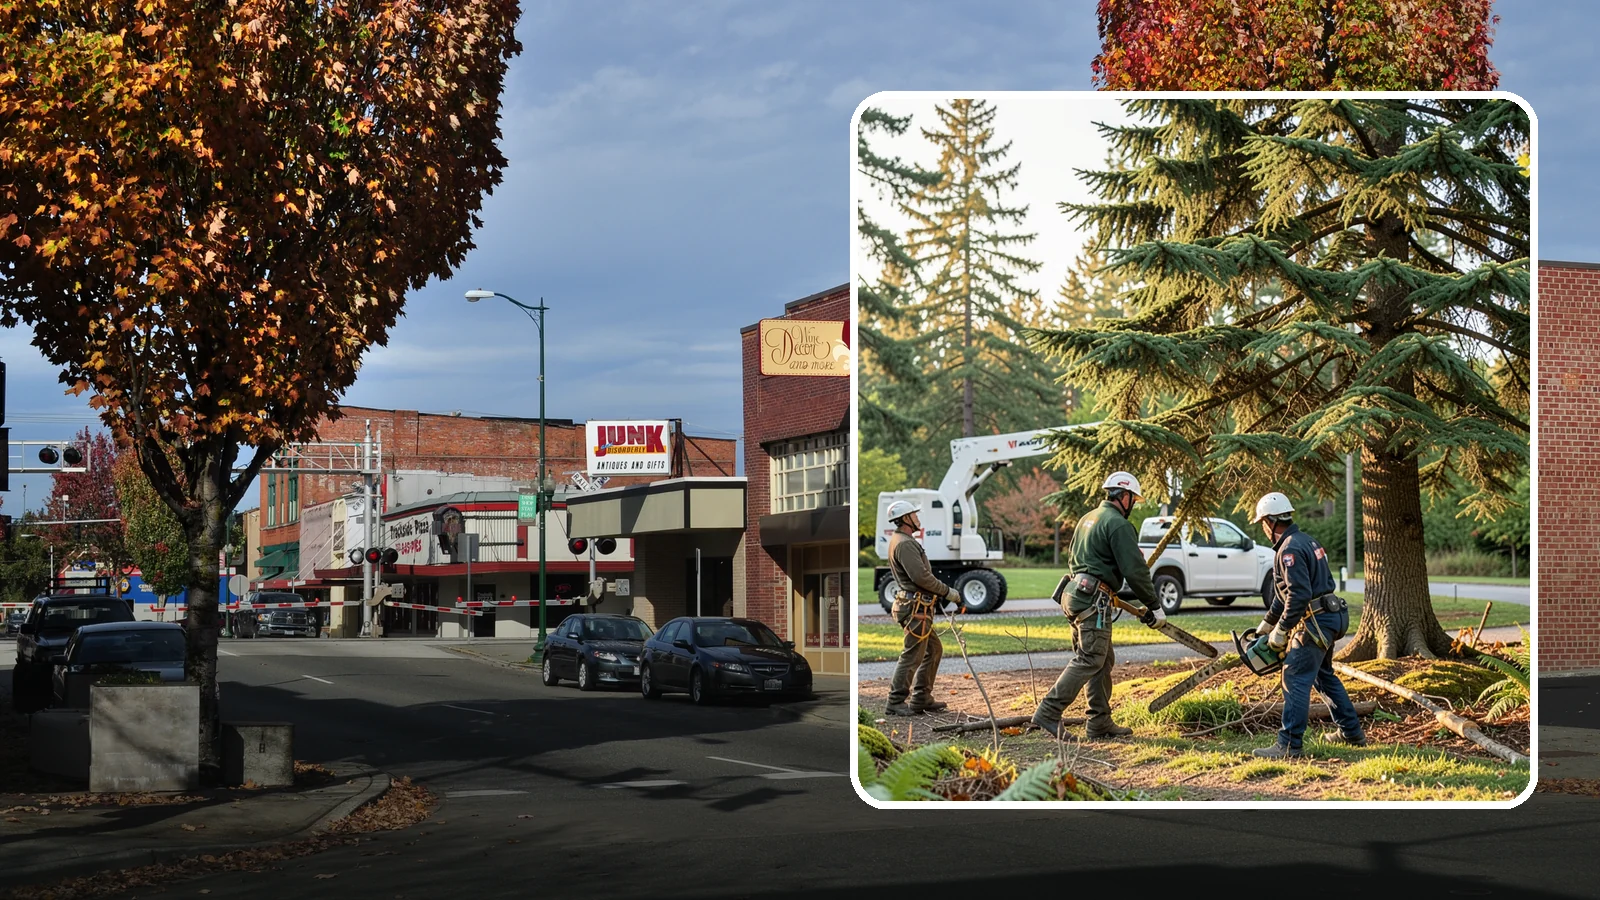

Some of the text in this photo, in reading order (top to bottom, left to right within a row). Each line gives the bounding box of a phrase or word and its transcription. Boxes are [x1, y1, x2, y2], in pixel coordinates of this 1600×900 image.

[595, 425, 665, 457] JUNK
[597, 460, 666, 470] ANTIQUES AND GIFTS
